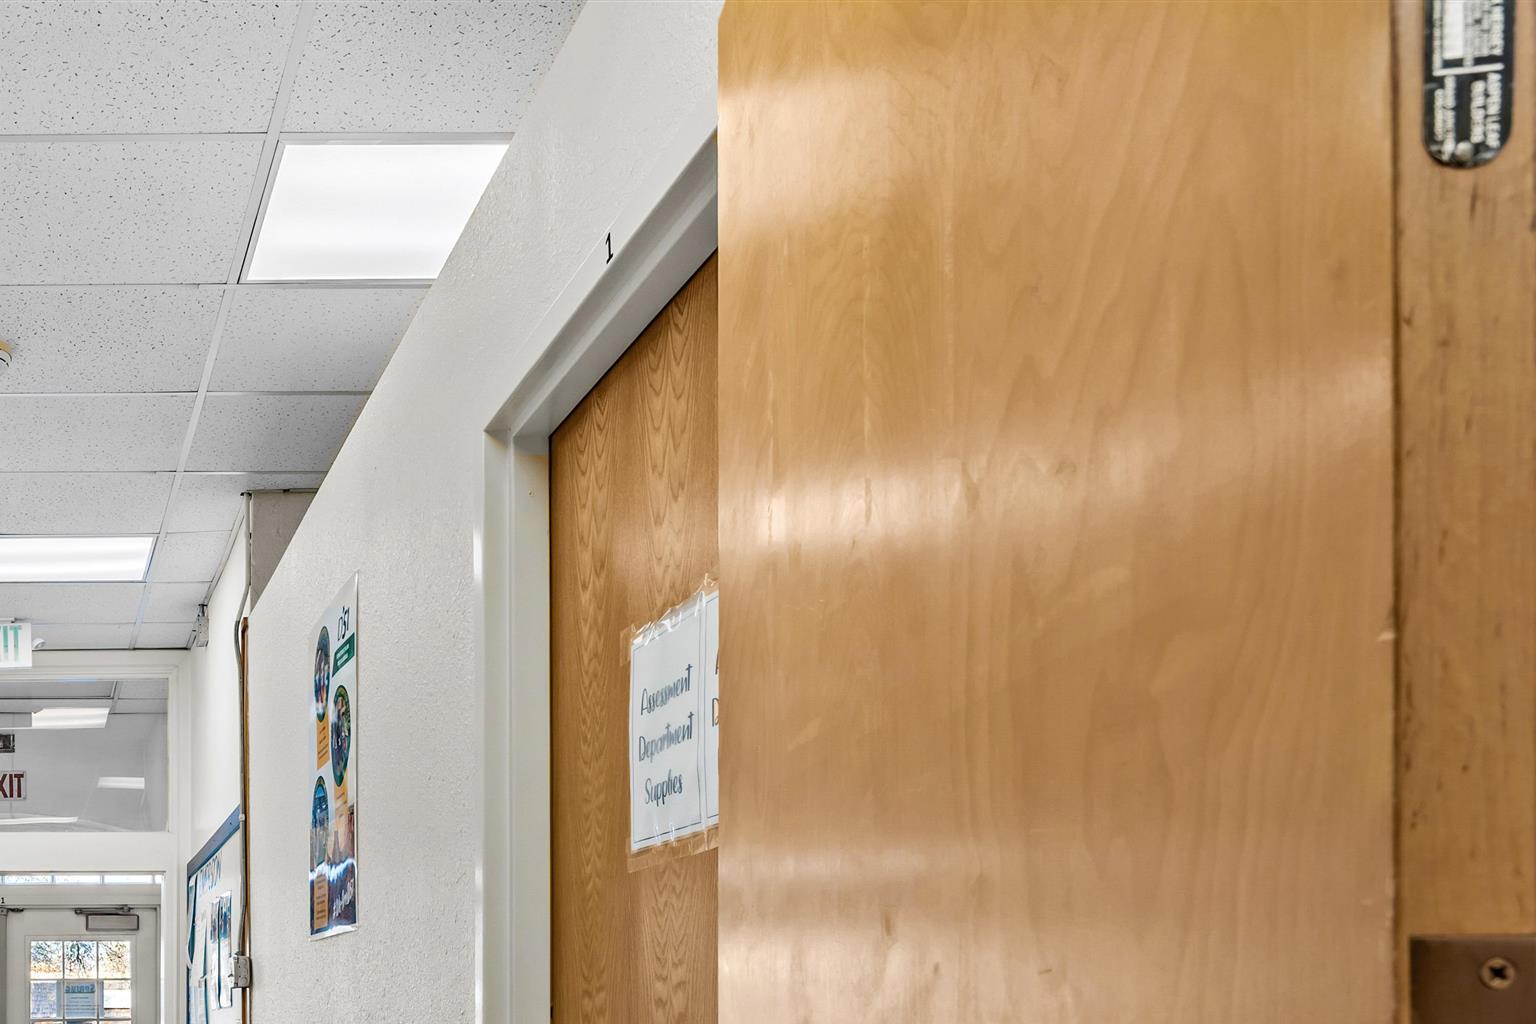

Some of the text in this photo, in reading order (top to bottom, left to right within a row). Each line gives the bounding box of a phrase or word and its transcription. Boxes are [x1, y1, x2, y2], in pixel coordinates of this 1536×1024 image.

[605, 231, 613, 264] 1
[640, 663, 693, 716] Assessment
[638, 711, 694, 764] Department
[644, 768, 683, 807] Supplies
